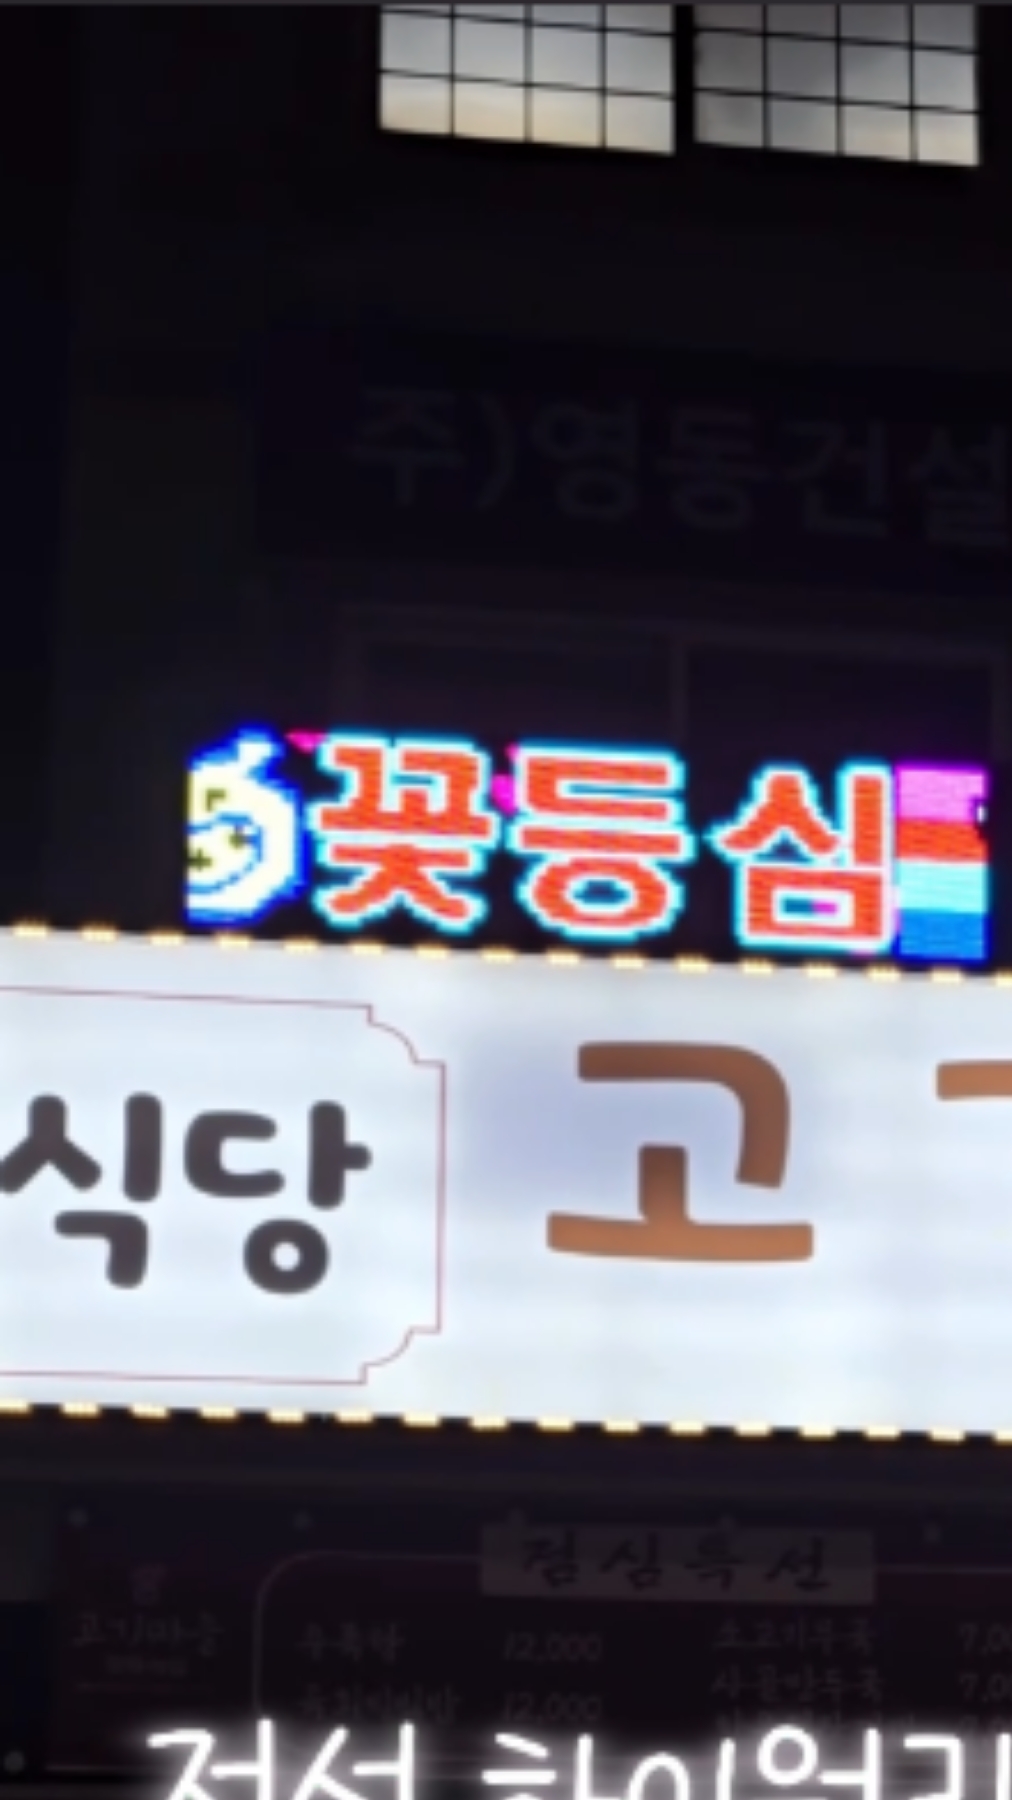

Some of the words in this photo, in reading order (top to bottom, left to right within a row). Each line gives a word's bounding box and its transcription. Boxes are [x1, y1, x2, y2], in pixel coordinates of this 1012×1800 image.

[313, 728, 895, 953] 꽃등심
[0, 1093, 371, 1295] 식당
[502, 1630, 603, 1663] 12,000
